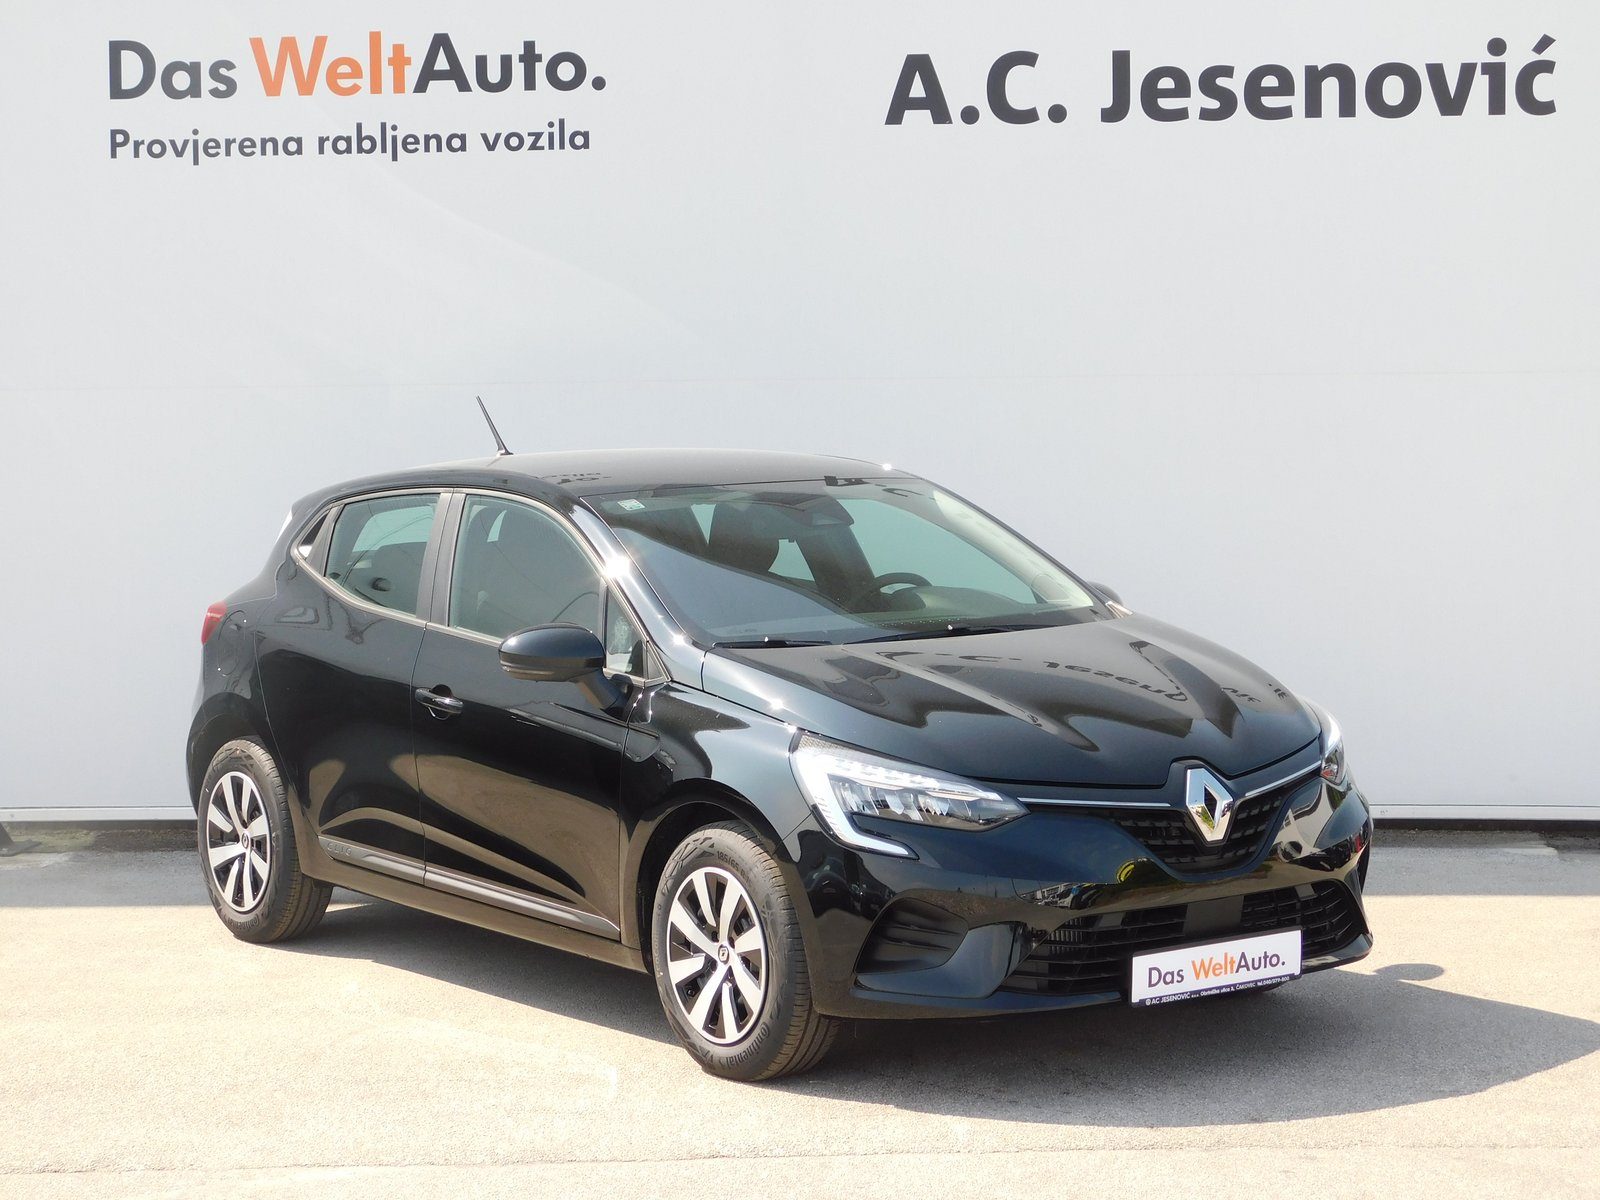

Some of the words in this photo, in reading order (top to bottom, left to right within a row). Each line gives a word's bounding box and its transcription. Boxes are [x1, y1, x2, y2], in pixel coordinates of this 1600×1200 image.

[108, 39, 238, 100] Das
[249, 31, 607, 97] WeltAuto.
[885, 51, 1067, 125] A.C.
[1101, 34, 1556, 123] Jesenović
[109, 128, 303, 166] Provjerena
[317, 121, 467, 162] rabljena
[480, 118, 590, 152] vozila
[1148, 967, 1184, 988] Das
[1192, 951, 1286, 980] WeltAuto.
